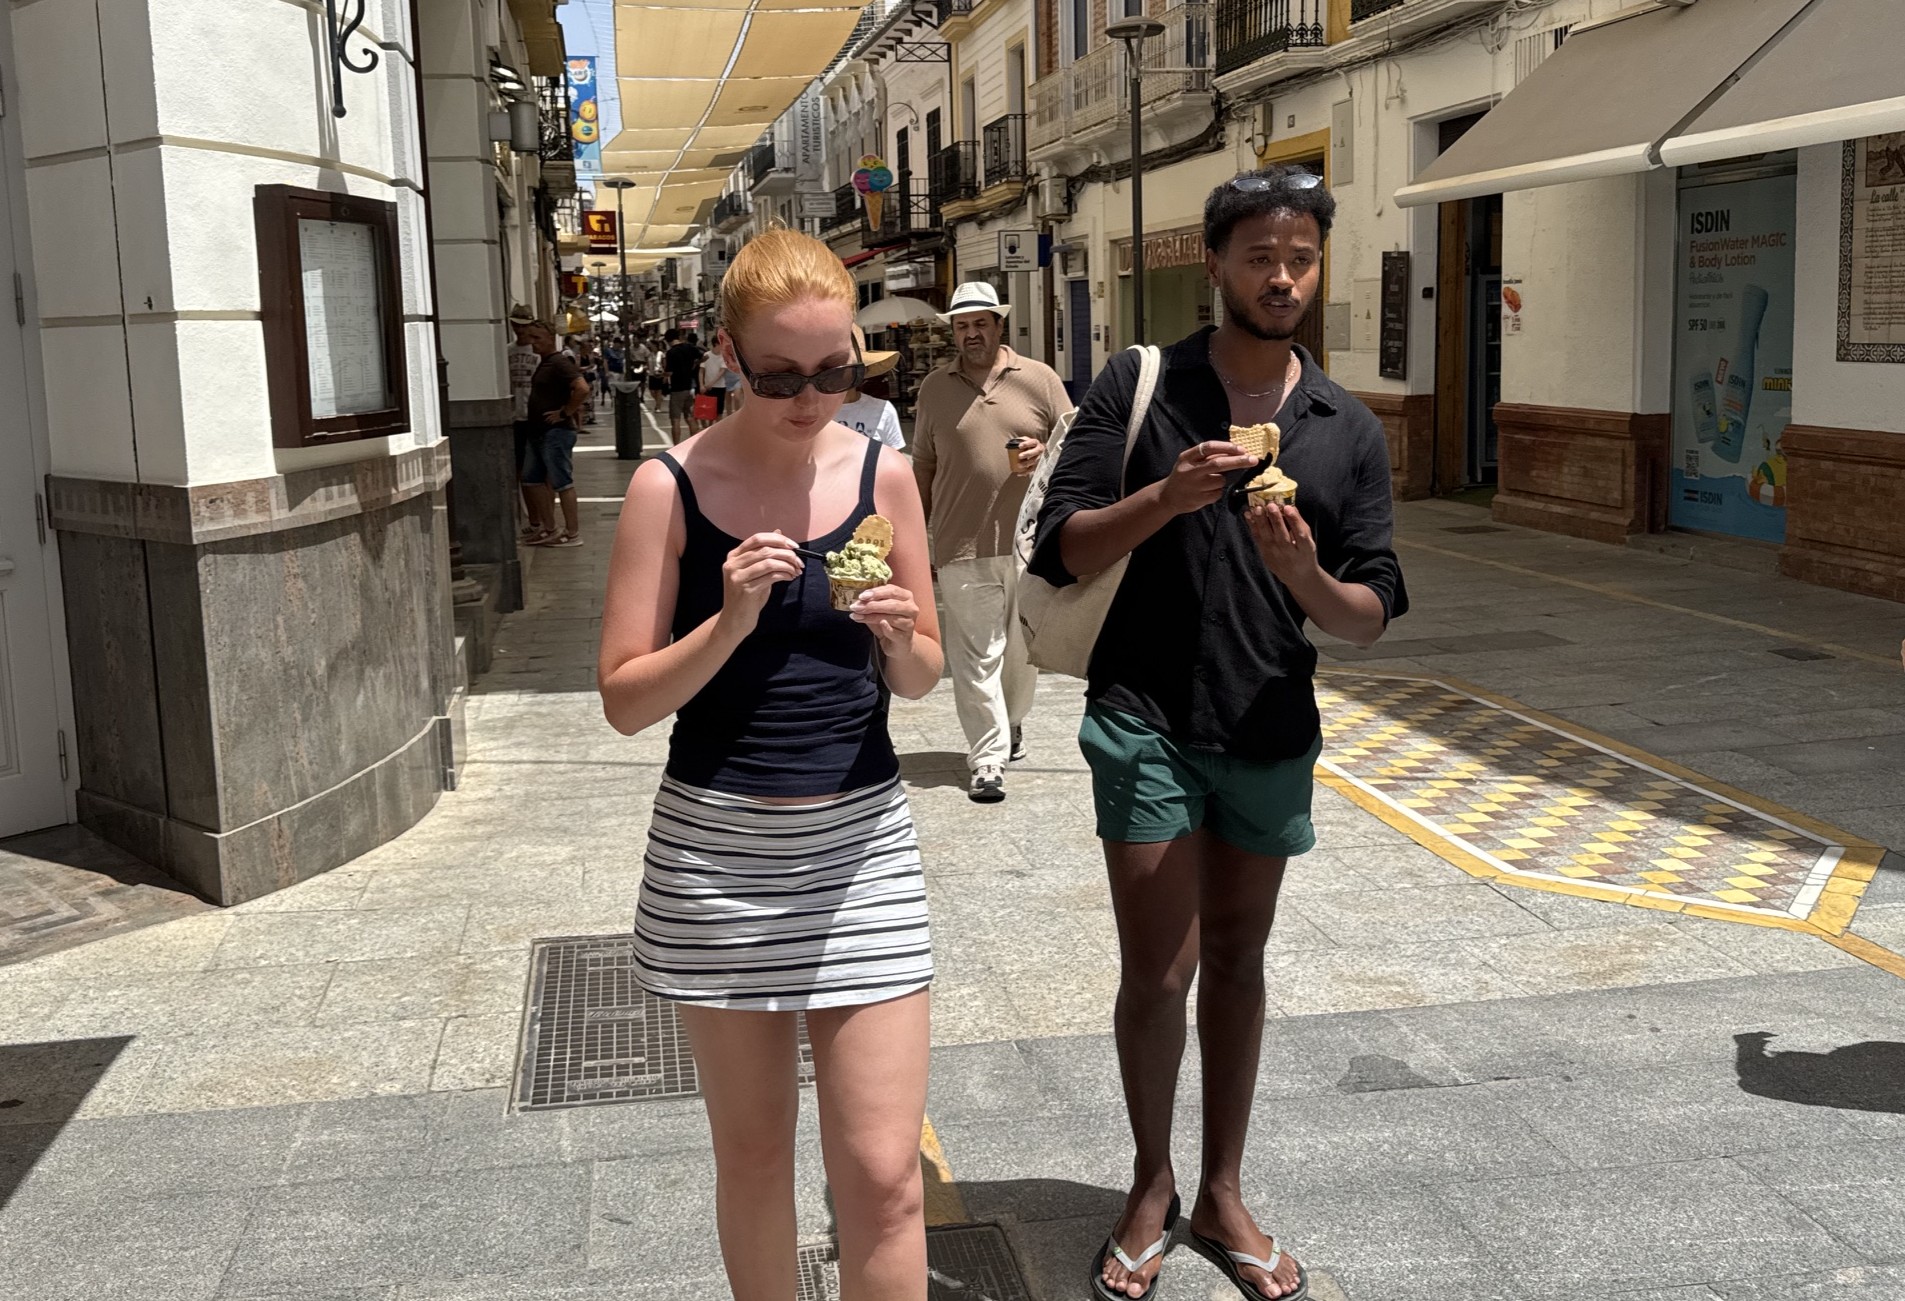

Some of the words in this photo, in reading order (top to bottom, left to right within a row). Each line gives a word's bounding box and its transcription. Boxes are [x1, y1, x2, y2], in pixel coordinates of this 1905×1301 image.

[1870, 189, 1881, 203] La
[1881, 187, 1899, 202] calle
[1690, 209, 1730, 234] ISDIN
[1751, 232, 1786, 249] MAGIC
[1688, 256, 1696, 268] &
[1698, 254, 1722, 270] Body
[1725, 253, 1756, 267] Lotion
[1688, 319, 1699, 331] SPF
[1700, 491, 1723, 505] ISDIN
